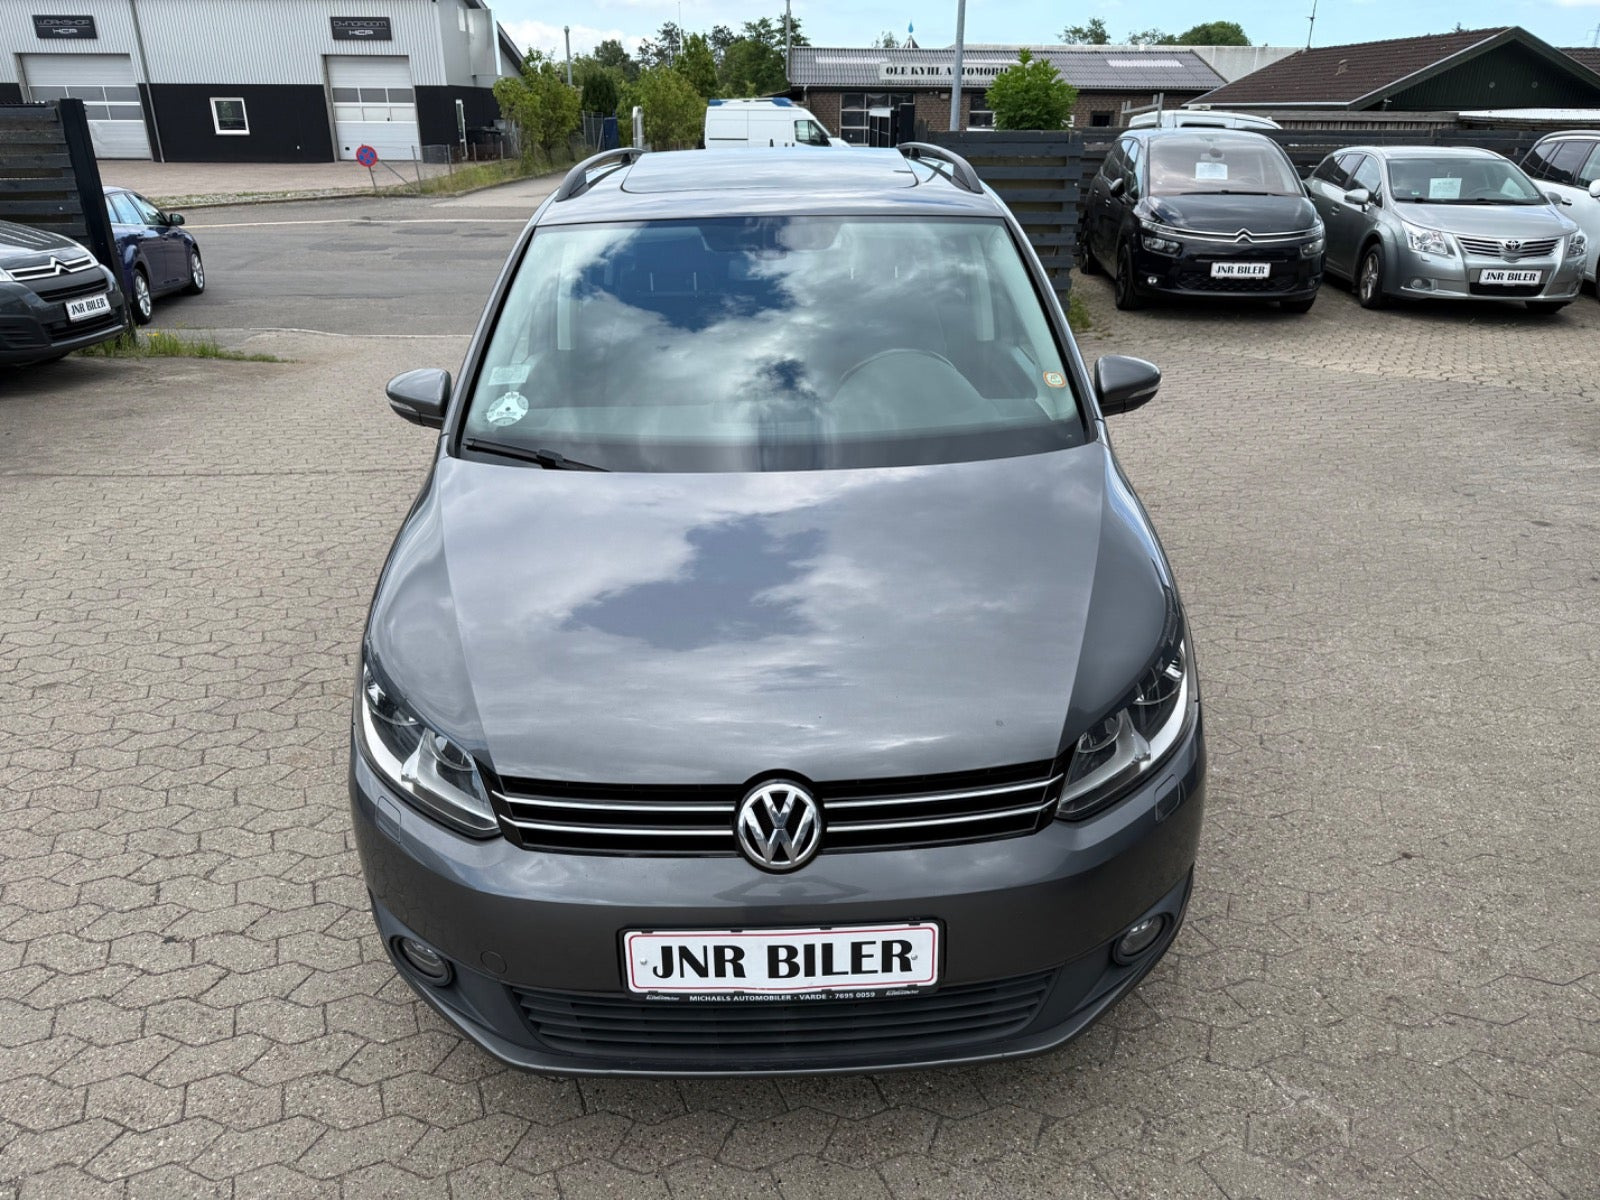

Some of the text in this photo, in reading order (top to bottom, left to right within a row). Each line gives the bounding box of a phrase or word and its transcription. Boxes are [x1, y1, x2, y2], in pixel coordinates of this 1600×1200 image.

[886, 66, 1009, 76] OLE KYHL ATOMOBI
[1216, 265, 1266, 275] JNR BILER
[1485, 271, 1537, 281] JNR BILER
[70, 297, 107, 315] JNR BILER
[652, 939, 914, 979] JNR BILER
[733, 994, 792, 1002] AUTOMOBILER
